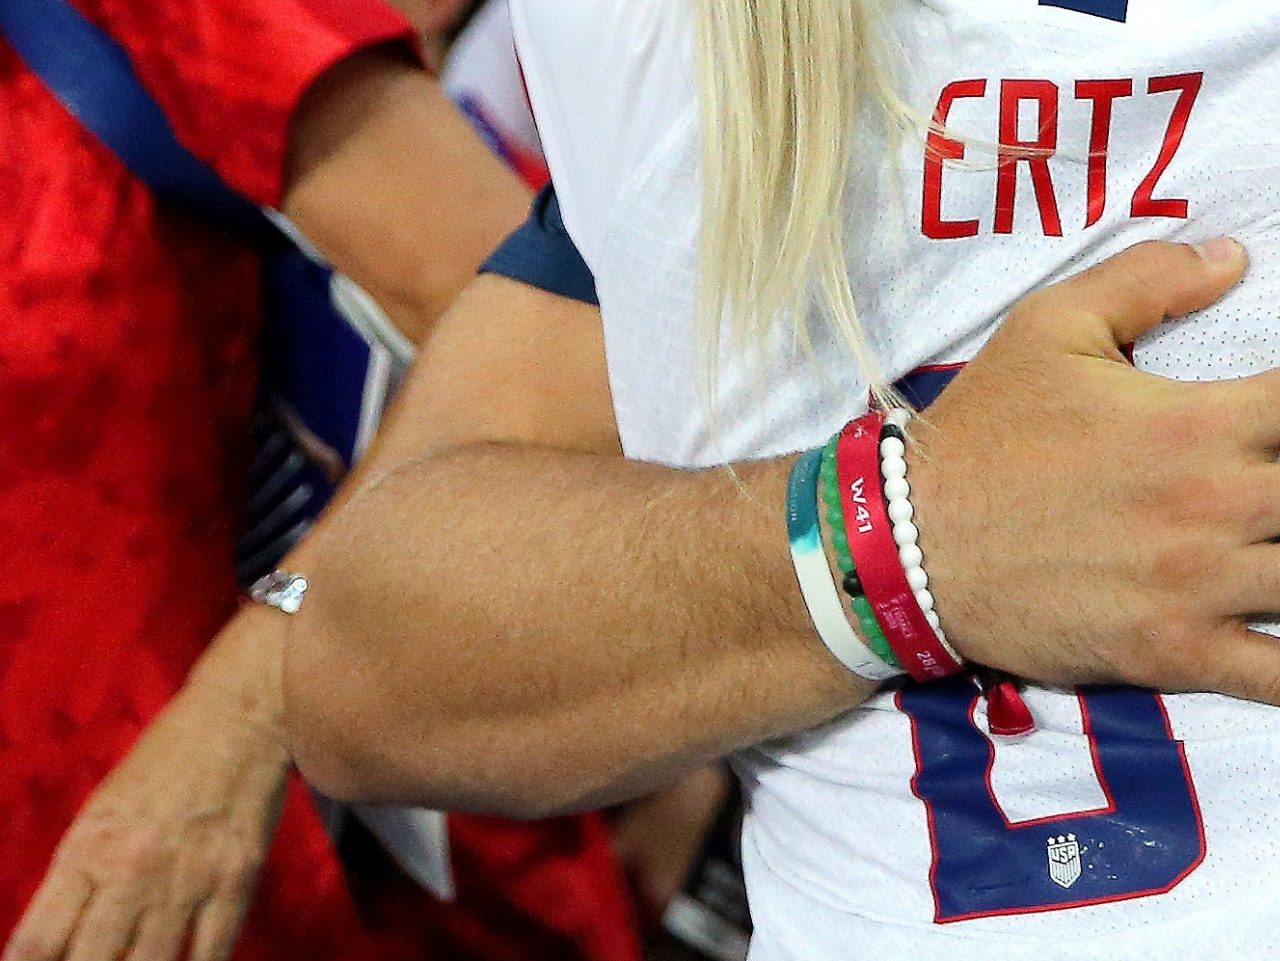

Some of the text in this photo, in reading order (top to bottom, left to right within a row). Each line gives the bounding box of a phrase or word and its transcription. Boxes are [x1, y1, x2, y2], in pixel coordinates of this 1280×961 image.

[921, 71, 1204, 240] ERTZ
[850, 475, 874, 534] W41
[1050, 843, 1077, 864] USA
